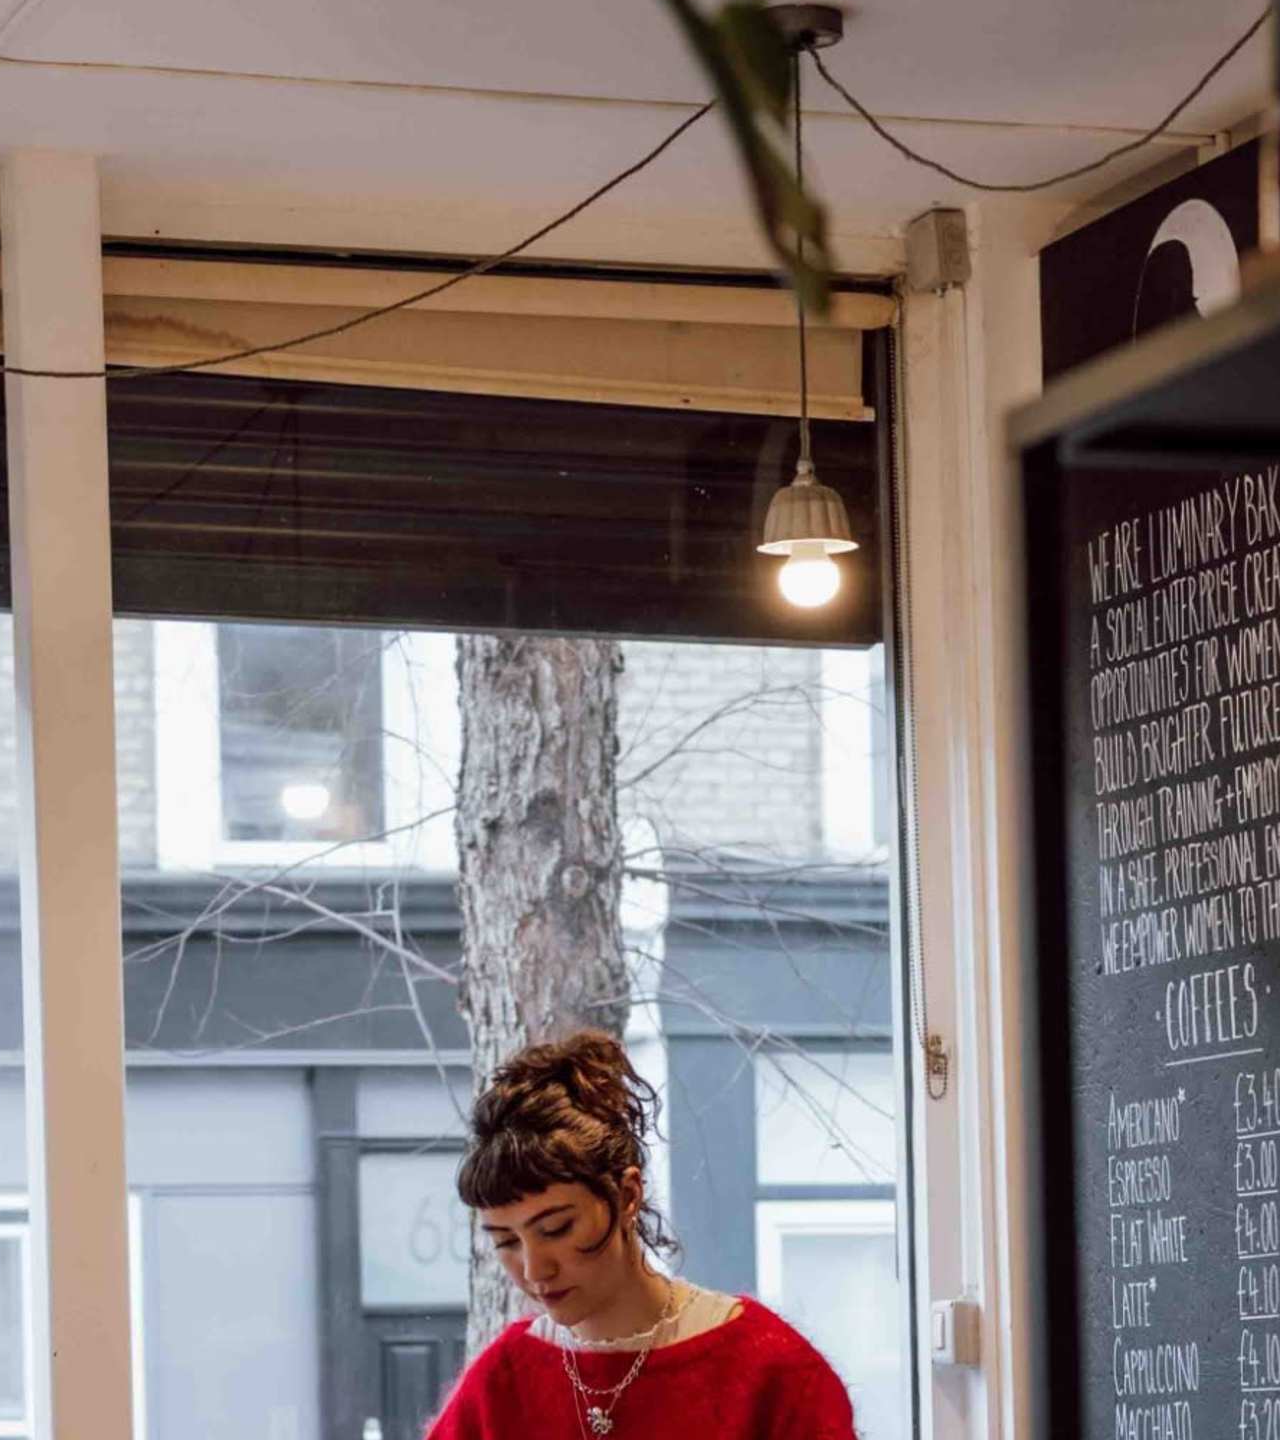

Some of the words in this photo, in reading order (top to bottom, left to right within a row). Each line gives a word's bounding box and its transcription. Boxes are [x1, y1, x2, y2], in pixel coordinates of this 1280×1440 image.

[1088, 531, 1111, 604] WE
[1114, 517, 1143, 595] ARE
[1148, 476, 1240, 583] LUMINARY
[1090, 615, 1101, 669] A
[1106, 596, 1153, 662] SOCIAL
[1153, 561, 1240, 649] ENTERPRISE
[1090, 643, 1189, 731] OPPORTUNITIES
[1195, 636, 1221, 699] FOR
[1093, 731, 1137, 796] BUILD
[1140, 701, 1215, 783] BRIGHTER
[1096, 795, 1157, 860] THROUGH
[1157, 774, 1223, 843] TRAINING
[1100, 864, 1114, 918] IN
[1118, 863, 1127, 914] A
[1164, 830, 1262, 902] PROFESSIONAL
[1101, 921, 1120, 975] WE
[1122, 908, 1181, 971] EMPOWER
[1183, 891, 1236, 958] WOMEN
[1237, 886, 1257, 945] TO
[1165, 962, 1259, 1051] COFFEES
[1108, 1155, 1170, 1207] ESPRESSO
[1233, 1140, 1278, 1191] £3.00
[1110, 1214, 1144, 1268] FLAT
[1146, 1209, 1189, 1264] WHITE
[1234, 1201, 1279, 1255] £4.00
[1237, 1264, 1280, 1316] £4.10
[1113, 1336, 1200, 1396] CAPPUCCINO
